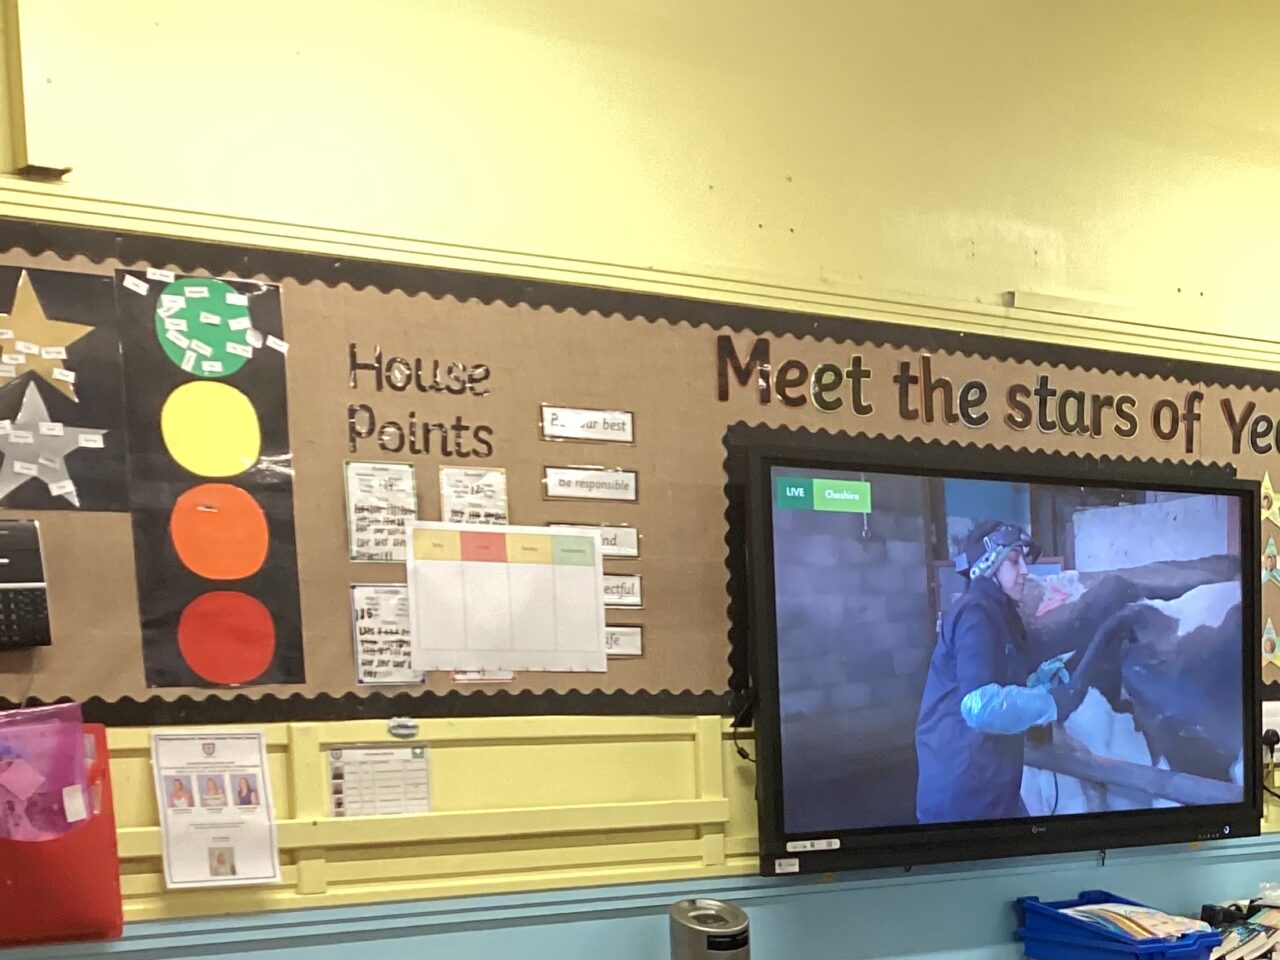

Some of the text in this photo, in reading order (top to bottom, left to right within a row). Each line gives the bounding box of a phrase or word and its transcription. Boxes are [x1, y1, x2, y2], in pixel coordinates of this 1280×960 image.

[348, 342, 490, 397] House
[717, 335, 873, 416] Meet
[893, 353, 989, 428] the
[1003, 375, 1139, 438] stars
[1153, 391, 1203, 454] of
[347, 403, 494, 458] Points
[602, 417, 626, 432] best
[575, 479, 630, 493] responsible
[786, 486, 805, 498] LIVE
[824, 489, 860, 500] Cheshire
